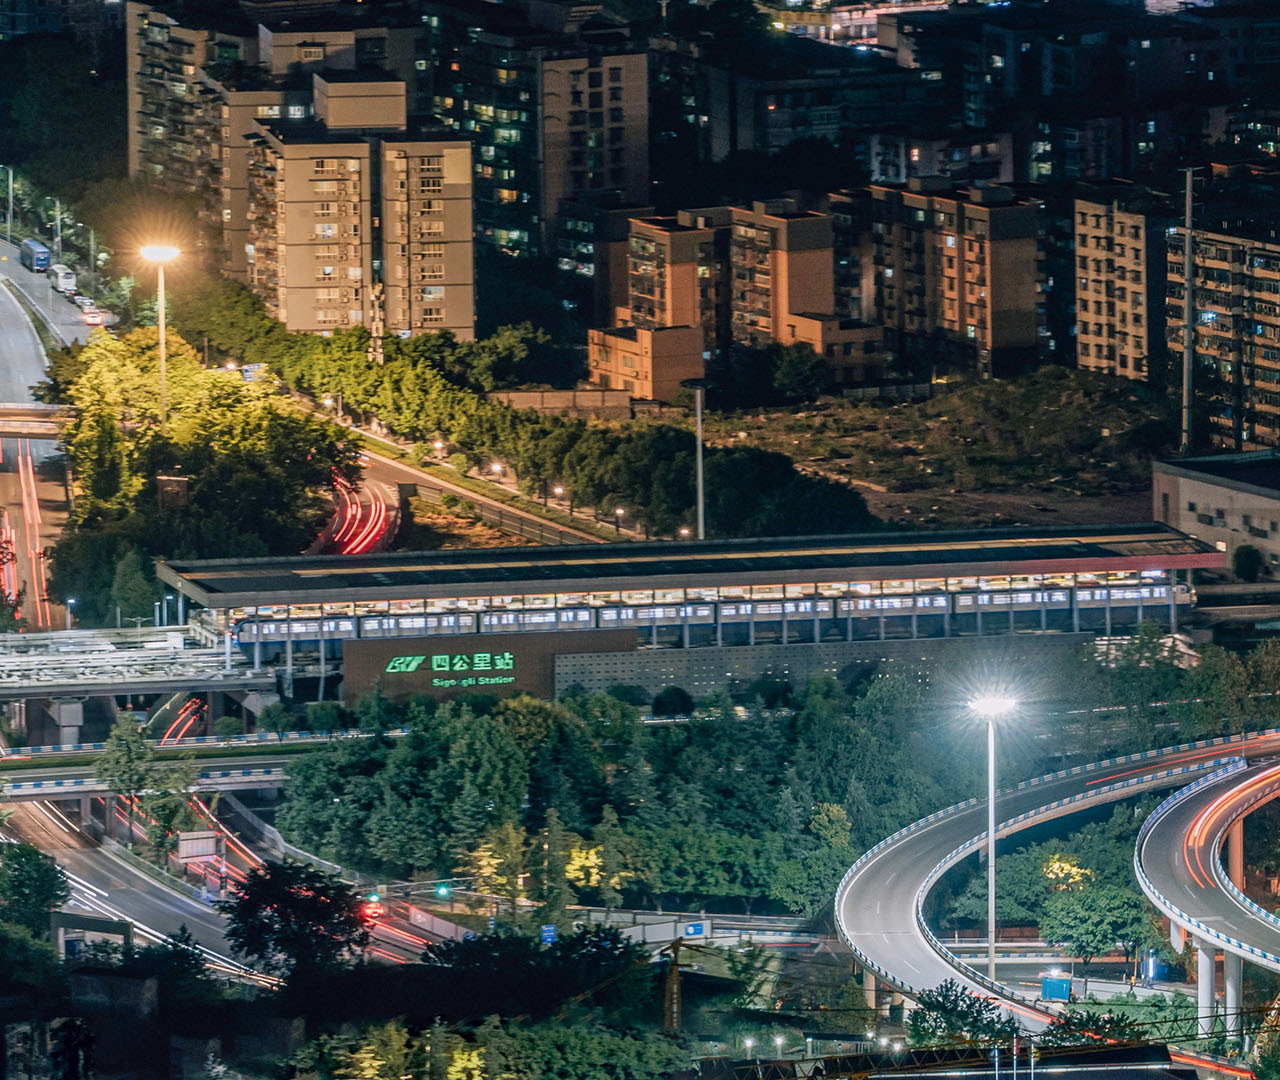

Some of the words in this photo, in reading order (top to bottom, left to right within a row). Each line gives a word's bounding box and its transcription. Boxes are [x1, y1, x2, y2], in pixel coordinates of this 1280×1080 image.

[431, 652, 514, 672] 四公里站
[432, 677, 476, 688] Sigogli
